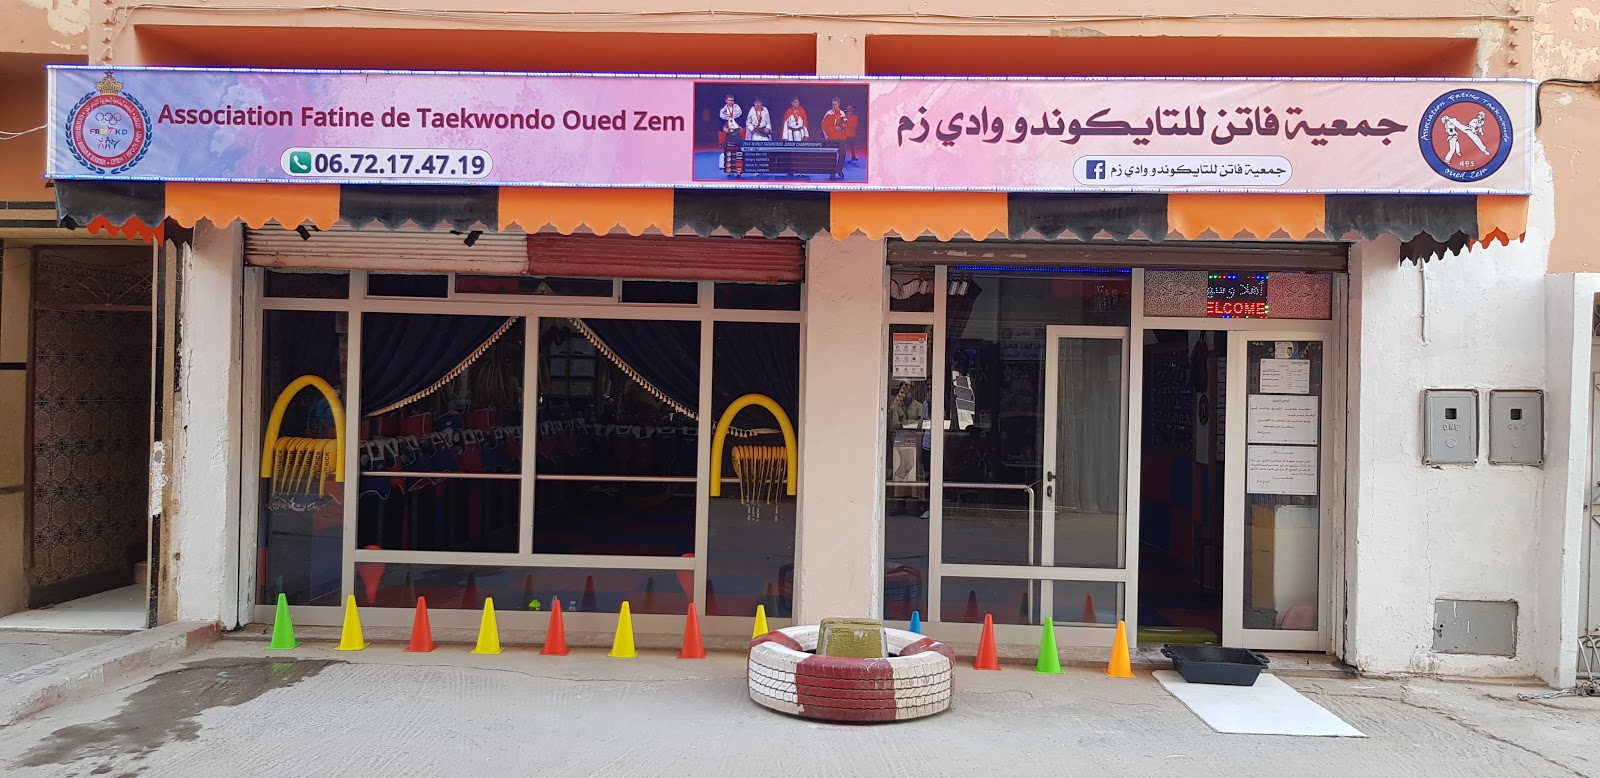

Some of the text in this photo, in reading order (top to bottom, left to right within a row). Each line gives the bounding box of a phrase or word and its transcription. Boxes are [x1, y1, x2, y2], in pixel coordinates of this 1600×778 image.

[1447, 91, 1480, 102] Fatine
[158, 104, 293, 126] Association
[301, 106, 374, 128] Fatine
[381, 107, 411, 128] de
[416, 108, 555, 130] Taekwondo
[562, 109, 626, 131] Oued
[633, 111, 685, 132] Zem
[897, 105, 1409, 147] جمعية فاتن للتايكوندو وادي زم
[315, 153, 485, 175] 06.72.17.47.19
[1110, 164, 1286, 178] جمعية فاتن للتايكوندو وادي زم
